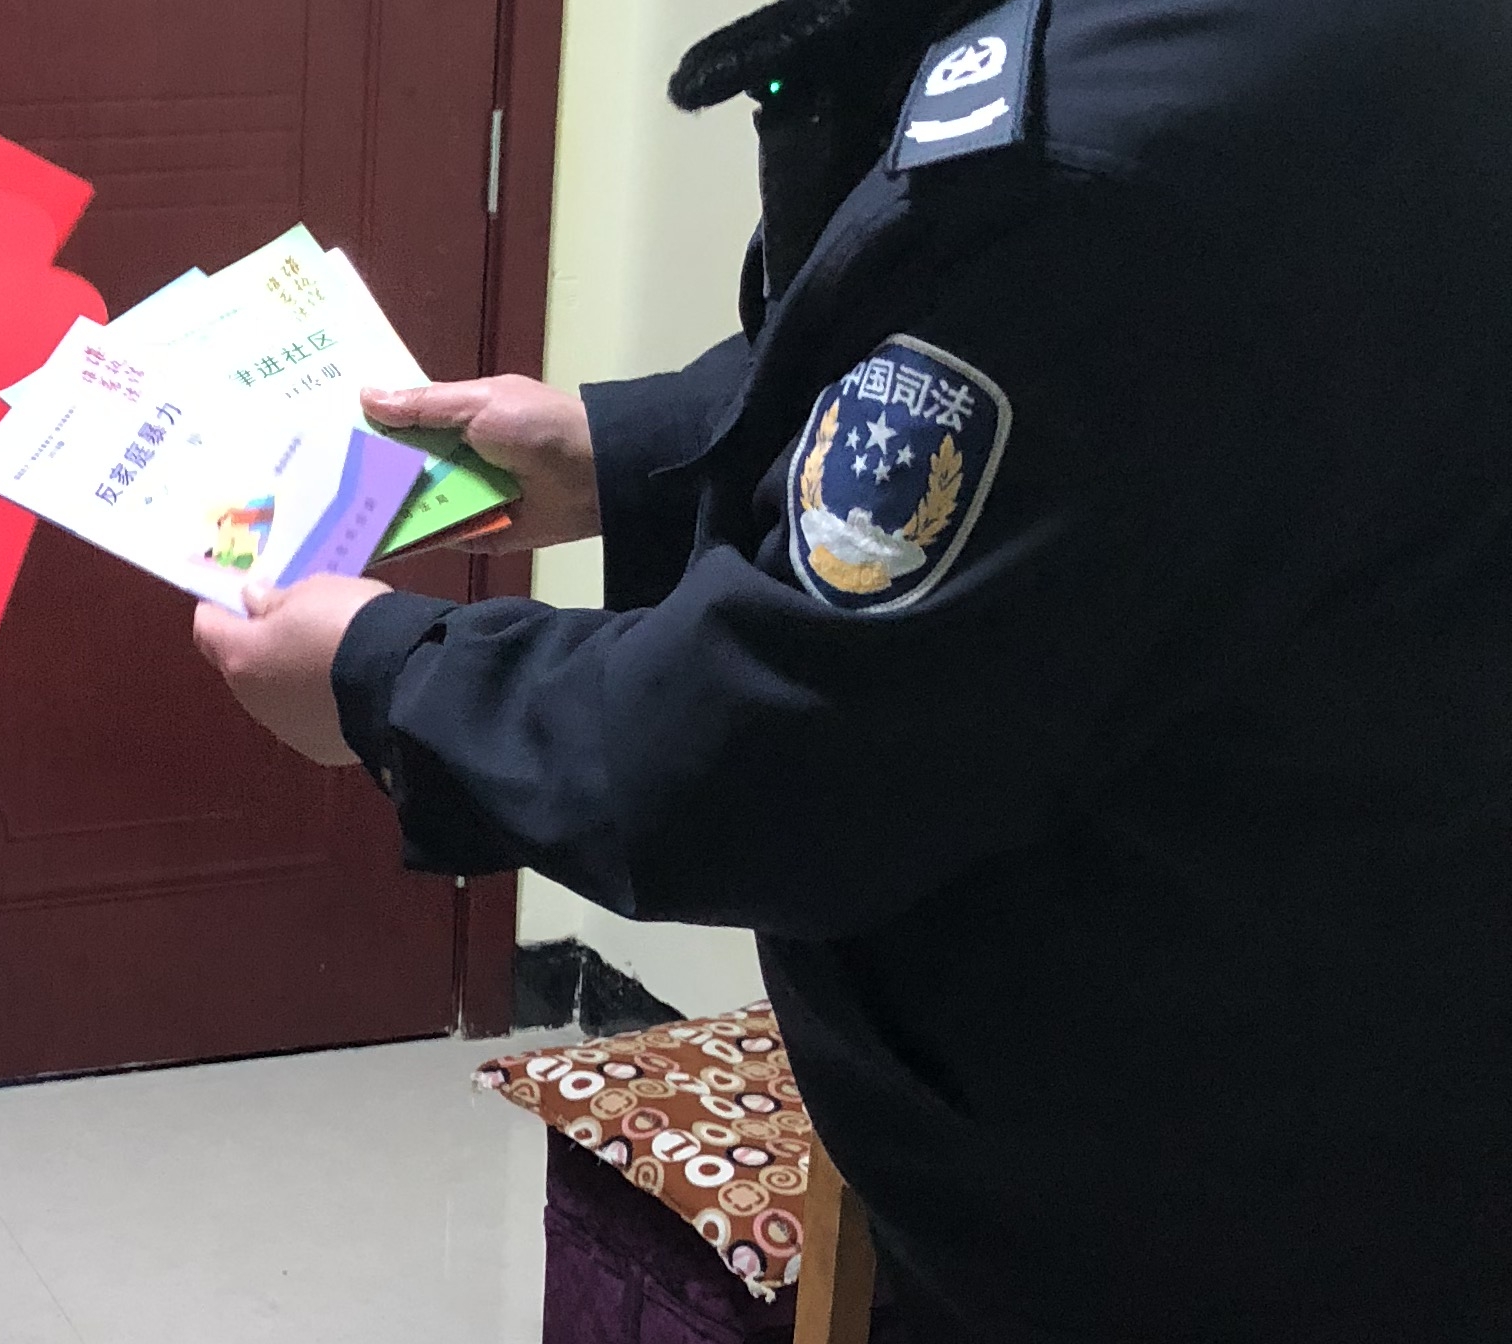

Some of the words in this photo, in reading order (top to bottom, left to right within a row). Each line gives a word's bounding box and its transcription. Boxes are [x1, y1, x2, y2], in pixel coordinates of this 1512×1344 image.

[839, 356, 976, 434] 中国司法
[94, 402, 182, 507] 反家庭暴力
